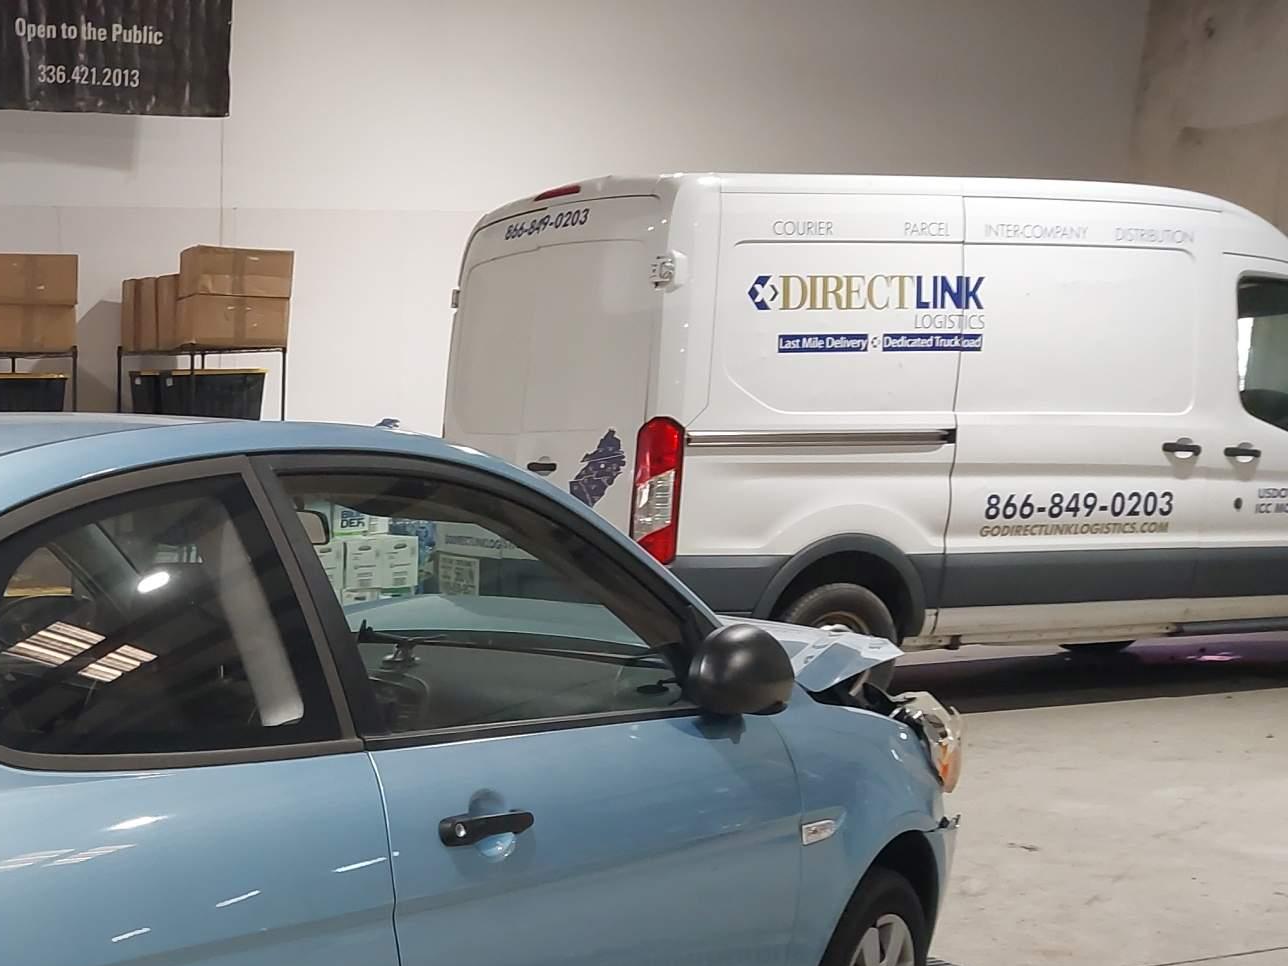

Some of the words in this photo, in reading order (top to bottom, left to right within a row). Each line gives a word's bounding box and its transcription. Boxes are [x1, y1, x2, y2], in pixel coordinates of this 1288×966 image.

[14, 17, 57, 42] Open
[61, 22, 78, 39] to
[81, 21, 108, 41] the
[112, 23, 164, 45] Public
[38, 63, 140, 88] 336.421.2013
[504, 207, 591, 241] 866-849-0203
[772, 220, 833, 236] COURIER
[904, 221, 951, 237] PARCEL
[1114, 227, 1196, 245] DISTRIBUTION
[778, 274, 986, 310] DIRECTLINK
[914, 314, 985, 330] LOGISTICS
[779, 337, 800, 349] Last
[802, 337, 824, 349] Mile
[825, 336, 868, 351] Delivery
[883, 335, 934, 349] Dedicated
[985, 491, 1174, 520] 866-849-0203
[979, 521, 1170, 538] GODIRECTLINKLOGISTICS.COM
